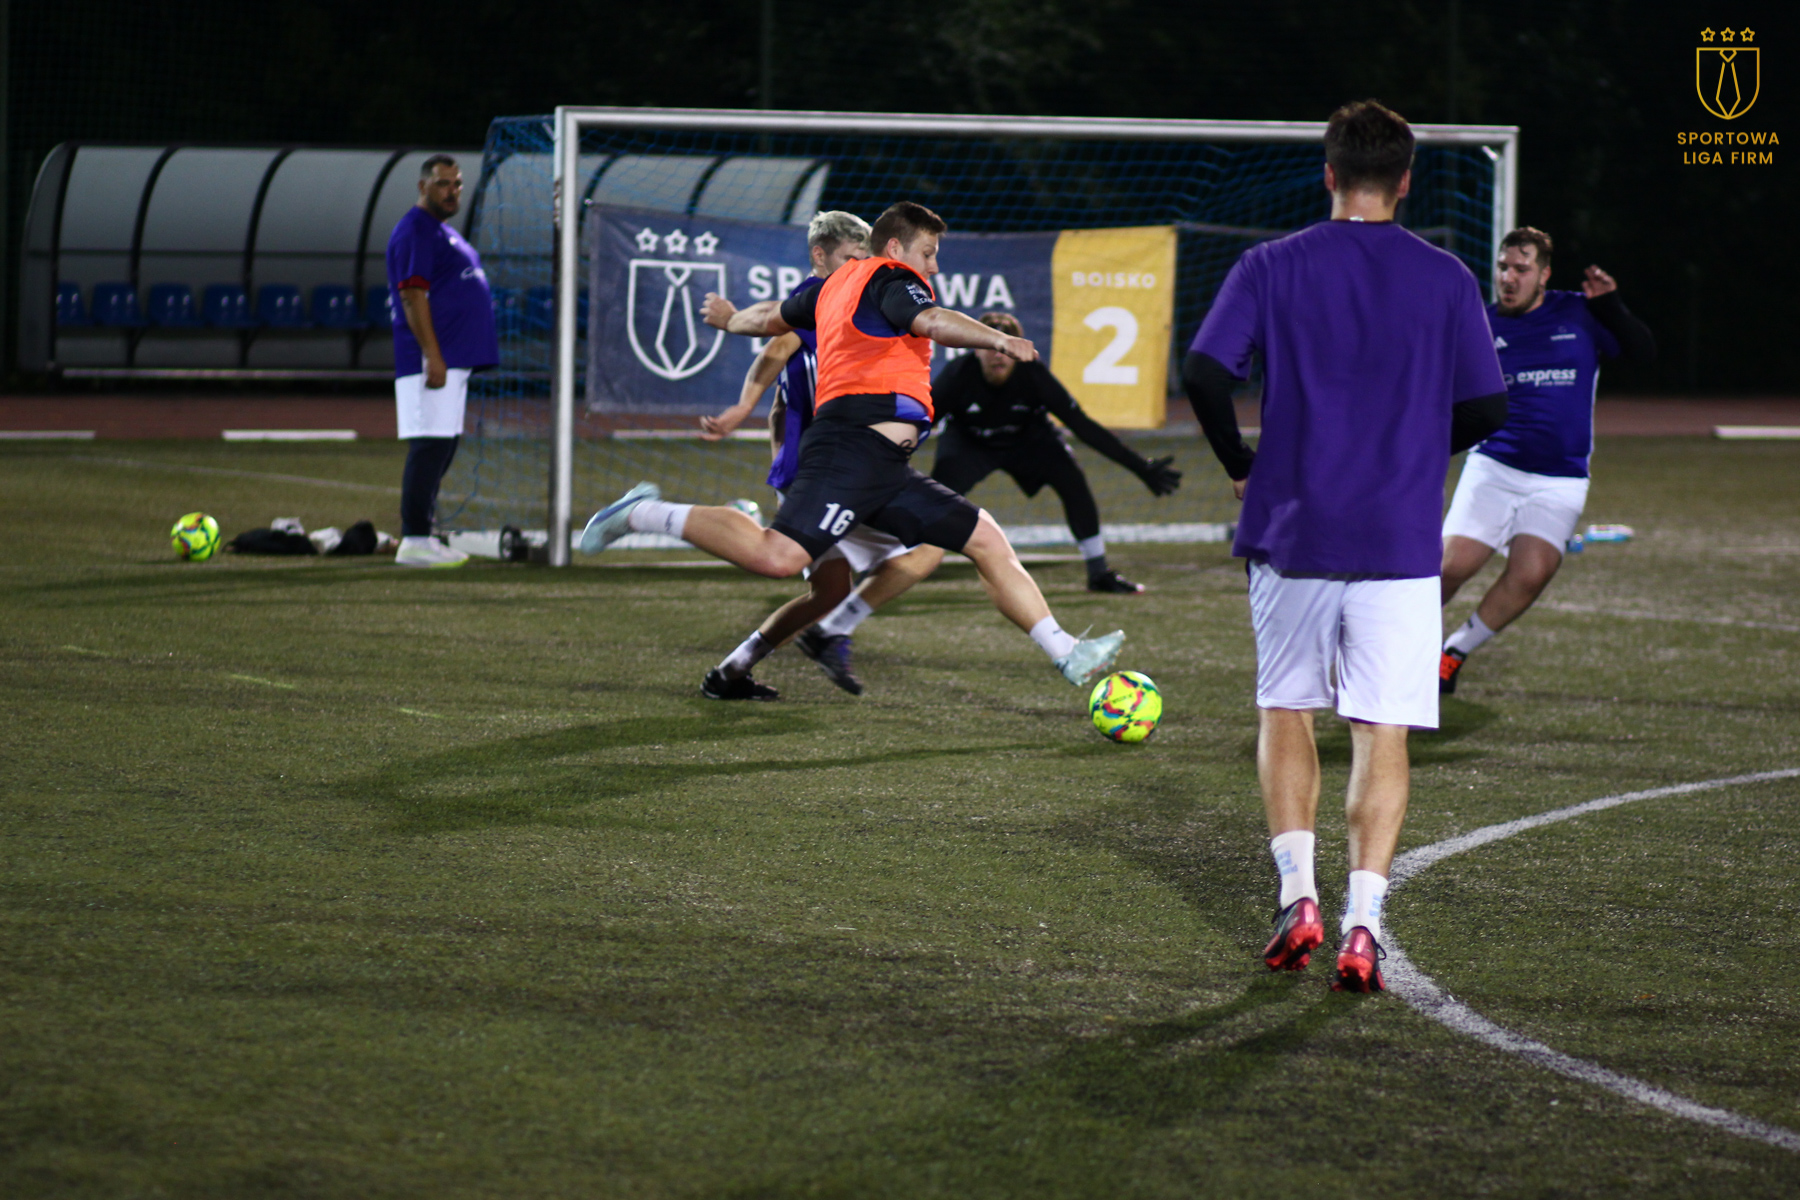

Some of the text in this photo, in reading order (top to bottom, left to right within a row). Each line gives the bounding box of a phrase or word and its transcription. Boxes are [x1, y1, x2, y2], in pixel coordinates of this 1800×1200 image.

[1072, 272, 1156, 288] BOISKO
[1082, 305, 1139, 385] 2
[1517, 368, 1577, 387] express
[818, 502, 856, 536] 16
